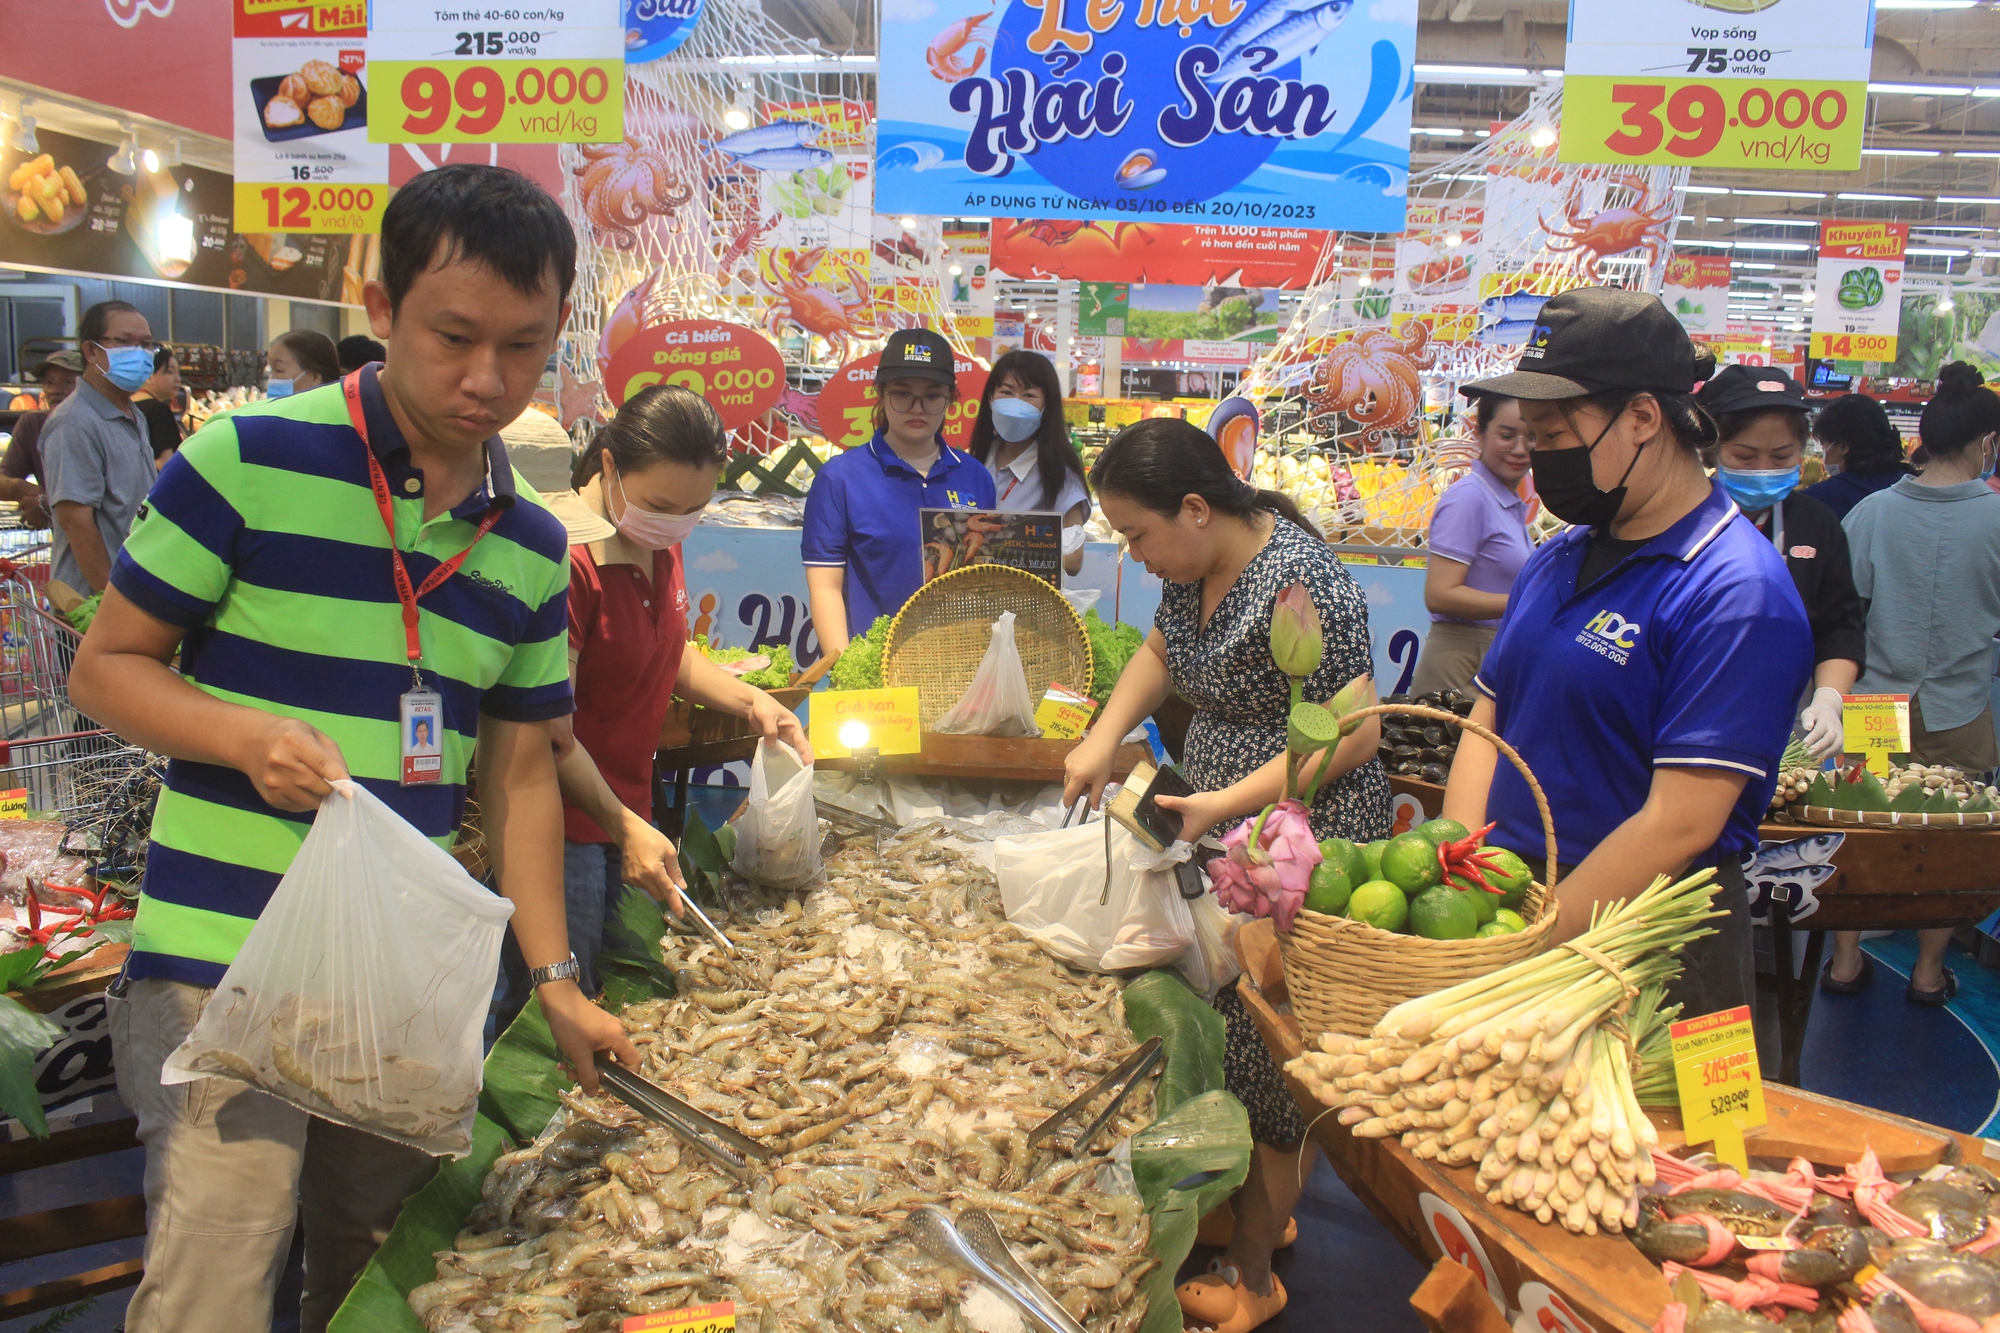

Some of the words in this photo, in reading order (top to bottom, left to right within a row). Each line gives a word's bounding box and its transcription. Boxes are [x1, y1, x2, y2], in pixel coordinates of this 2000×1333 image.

[319, 4, 367, 28] Mãi
[435, 10, 463, 21] Tôm
[463, 9, 481, 21] thẻ
[484, 10, 520, 21] 40-60
[523, 9, 565, 22] con/kg
[1690, 26, 1719, 41] Vọp
[1723, 25, 1757, 41] sống
[454, 31, 541, 56] 215.000
[507, 45, 537, 56] vnd/kg
[1686, 47, 1771, 74] 75.000
[1731, 65, 1766, 76] vnd/kg
[400, 66, 609, 136] 99.000
[948, 50, 1134, 179] Hải
[1156, 45, 1337, 149] Sản
[1603, 83, 1848, 158] 39.000
[519, 109, 598, 137] vnd/kg
[1740, 133, 1831, 165] vnd/kg
[261, 186, 374, 228] 12.000
[964, 191, 986, 207] ÁP
[991, 195, 1036, 211] DỤNG
[1041, 194, 1064, 210] TỪ
[1067, 195, 1111, 212] NGÀY
[1115, 197, 1168, 214] 05/10
[1172, 197, 1207, 215] ĐẾN
[1211, 201, 1316, 220] 20/10/2023
[321, 213, 365, 229] vnd/lô
[1194, 225, 1217, 236] Trên
[1219, 225, 1259, 237] 1.000
[1261, 228, 1278, 238] sản
[1279, 227, 1308, 241] phẩm
[1828, 226, 1882, 242] Khuyến
[1201, 238, 1212, 248] rẻ
[1214, 239, 1233, 249] hơn
[1235, 239, 1254, 250] đến
[1256, 239, 1278, 251] cuối
[1279, 241, 1301, 252] năm
[1866, 237, 1899, 256] Mãi!
[665, 330, 690, 345] Cá
[692, 325, 732, 344] biển
[1530, 325, 1552, 347] DC
[653, 346, 707, 366] Đồng
[710, 346, 742, 366] giá
[904, 343, 932, 357] HDC
[1822, 334, 1888, 358] 14.900
[1857, 351, 1884, 360] vnd/kg
[720, 391, 754, 406] vnd
[943, 421, 962, 435] nd
[946, 489, 977, 507] HDC
[1024, 524, 1054, 538] HDC
[1004, 539, 1026, 548] HDC
[1026, 541, 1057, 549] Seafood
[1028, 560, 1057, 569] MAU
[396, 569, 411, 607] ENTRAL
[1584, 609, 1641, 649] HDC
[1575, 634, 1628, 666] 0912.006.006
[1607, 644, 1630, 657] NOTHING
[1884, 703, 1908, 711] con/kg
[1686, 1013, 1719, 1033] KHUYẾN
[1719, 1012, 1735, 1025] MÃI
[1675, 1041, 1690, 1053] Cua
[1735, 1025, 1752, 1036] mau
[645, 1310, 689, 1327] KHUYẾN
[690, 1307, 711, 1319] MÃI
